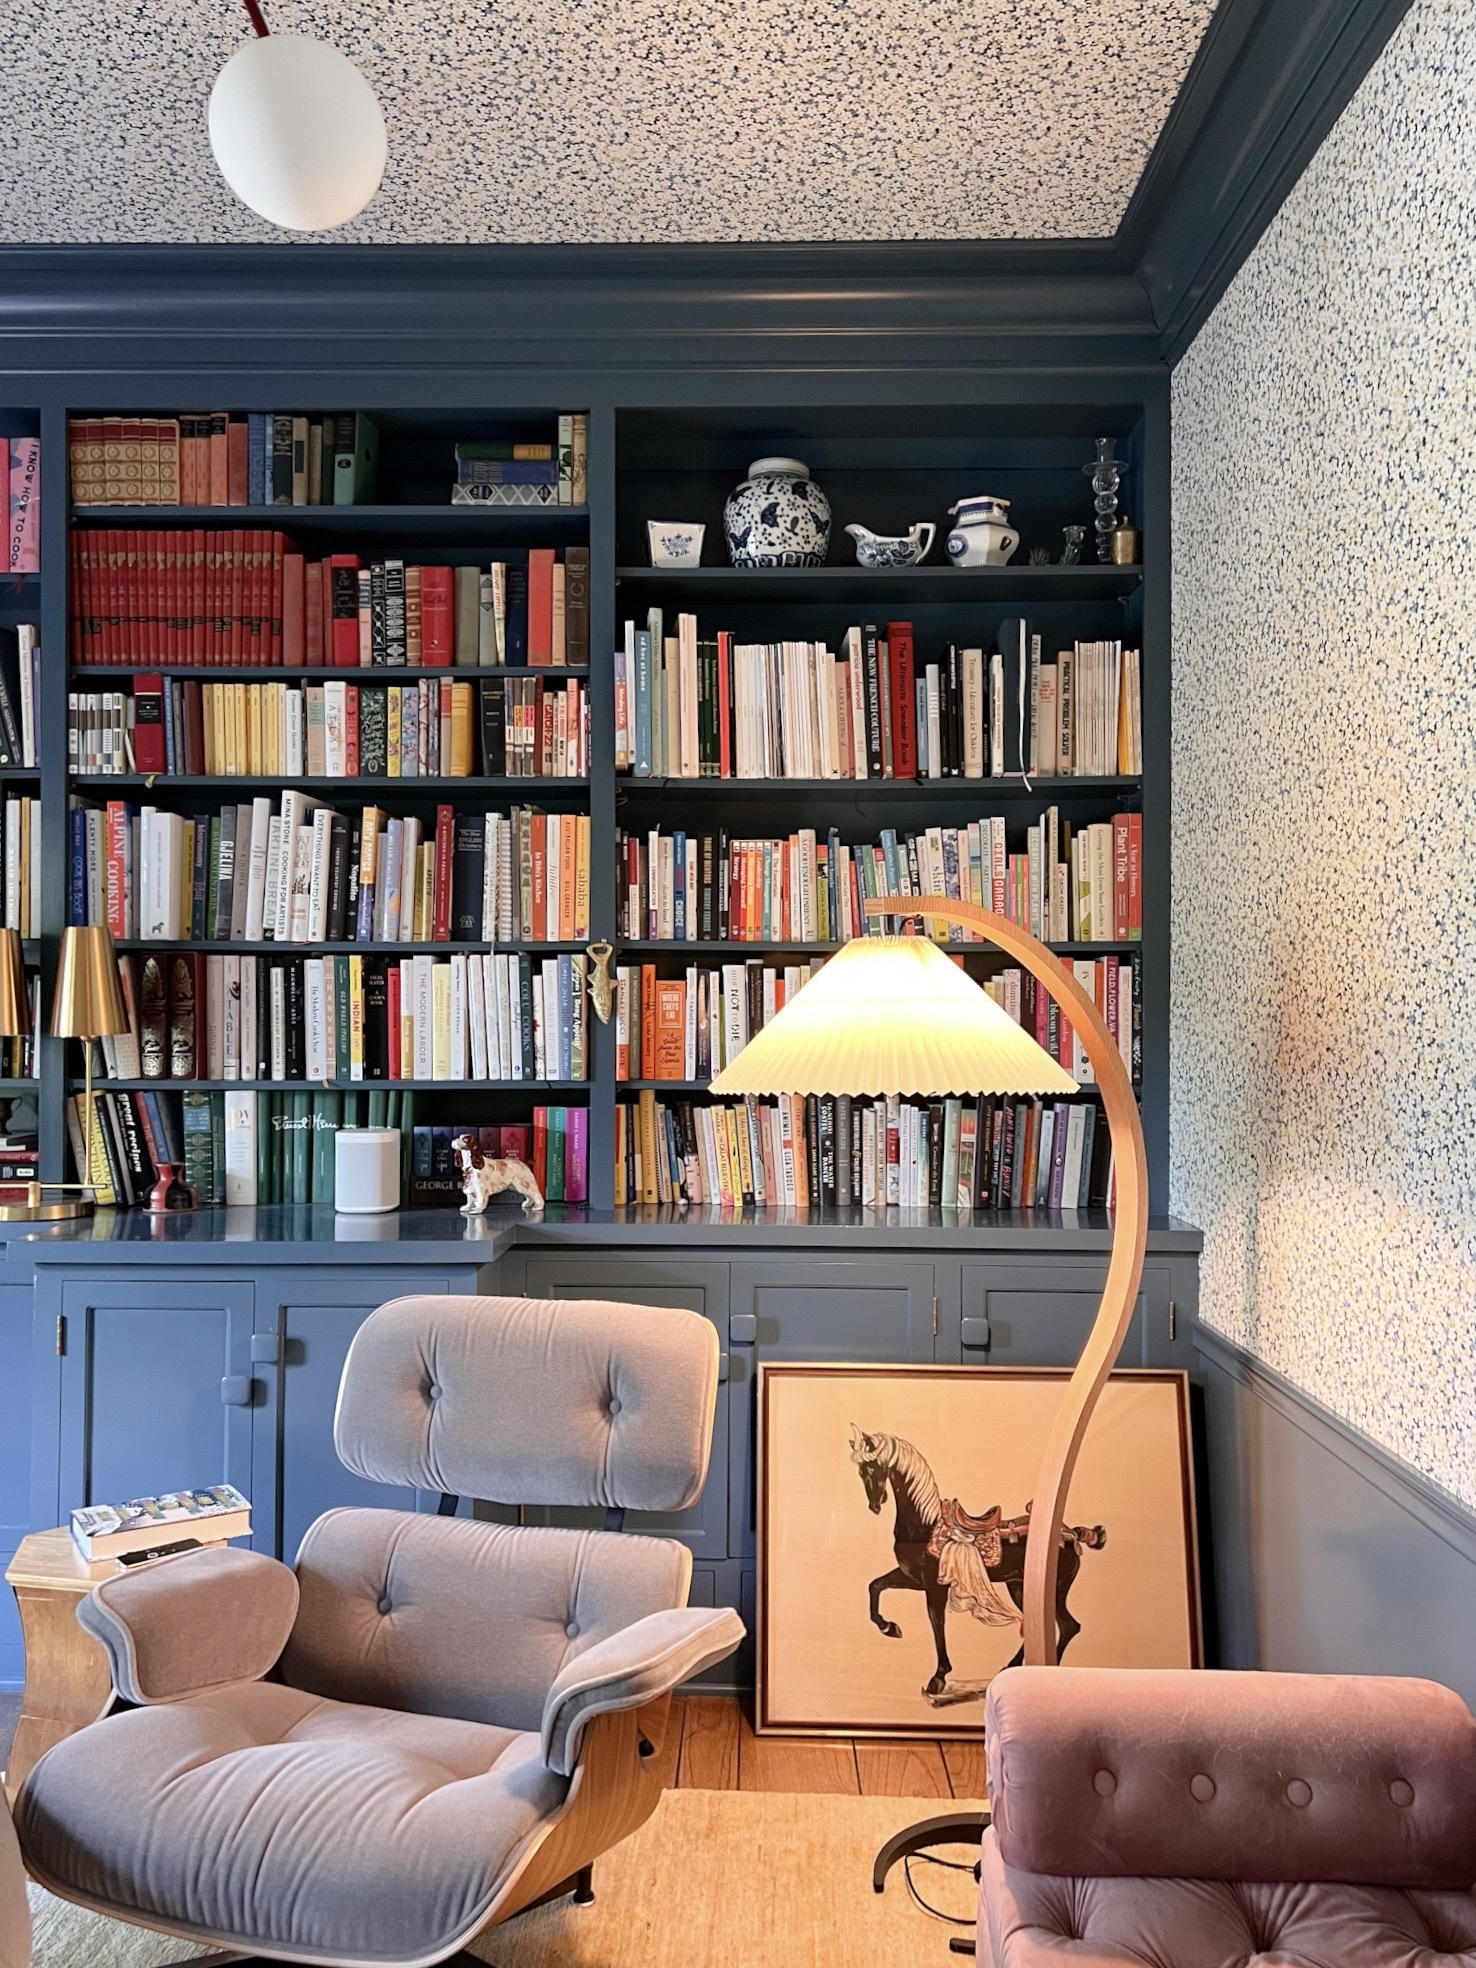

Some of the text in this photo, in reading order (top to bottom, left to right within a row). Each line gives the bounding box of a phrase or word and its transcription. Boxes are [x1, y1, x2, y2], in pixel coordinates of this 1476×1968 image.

[25, 452, 37, 484] KNOW
[20, 486, 31, 513] HOW
[16, 518, 25, 532] TO
[11, 536, 21, 567] COOK
[641, 637, 646, 646] ad
[900, 662, 908, 700] Ultimate
[968, 659, 976, 685] Treasury
[868, 638, 879, 752] THE NEW FRENCH COUTURE
[195, 824, 205, 868] bistronomy
[315, 815, 324, 859] EVERYTHING
[704, 837, 712, 852] TRIBE
[1031, 829, 1040, 873] DECORATING
[1117, 827, 1128, 882] Plant Tribe
[107, 808, 125, 923] ALPINE COOKING
[219, 841, 234, 880] GJELINA
[266, 819, 281, 927] TARTINE BREAD
[995, 842, 1005, 877] GIRLS
[313, 888, 318, 897] TO
[349, 865, 358, 901] Nopalito
[578, 868, 587, 907] sababa
[932, 866, 943, 892] skin
[1031, 875, 1040, 893] WITH
[675, 900, 684, 927] CHOICE
[1010, 982, 1018, 1015] domino
[732, 1024, 740, 1042] DIE
[1050, 1004, 1059, 1055] bloom wild
[118, 1094, 142, 1172] great recipes
[1002, 1107, 1014, 1197] MONA AWAD BUNNY
[416, 1181, 457, 1190] GEORGE
